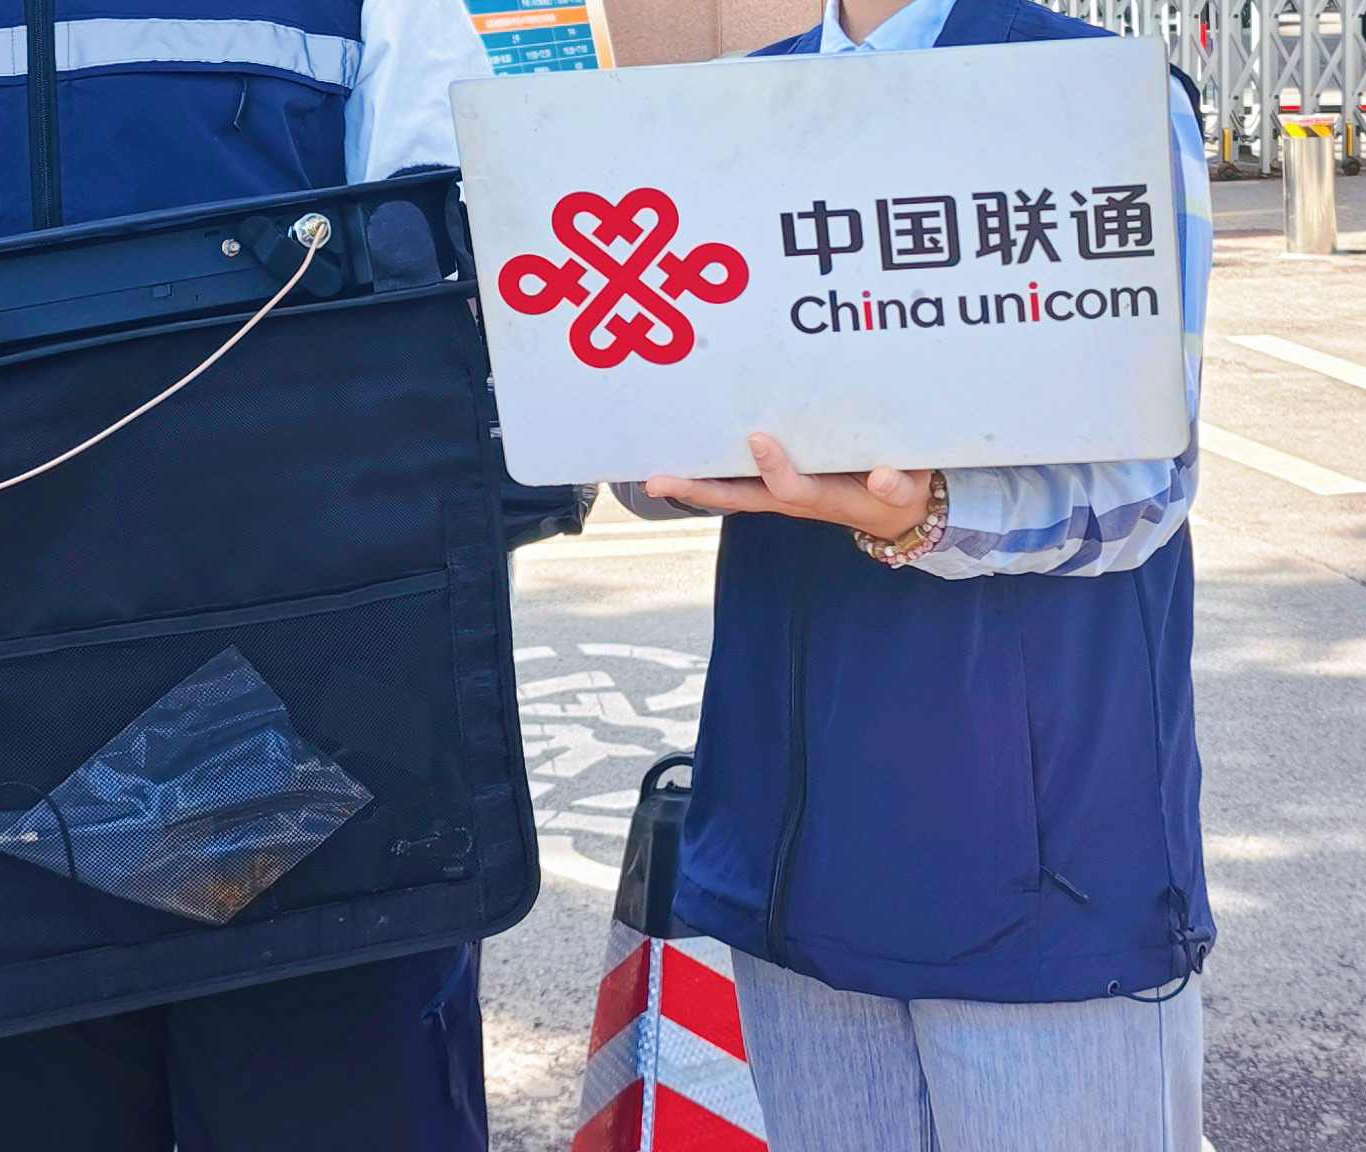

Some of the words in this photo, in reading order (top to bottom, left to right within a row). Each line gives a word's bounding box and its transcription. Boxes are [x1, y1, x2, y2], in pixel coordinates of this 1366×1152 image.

[780, 183, 1157, 276] 中国联通
[790, 290, 944, 335] China
[960, 282, 1159, 327] unicom
